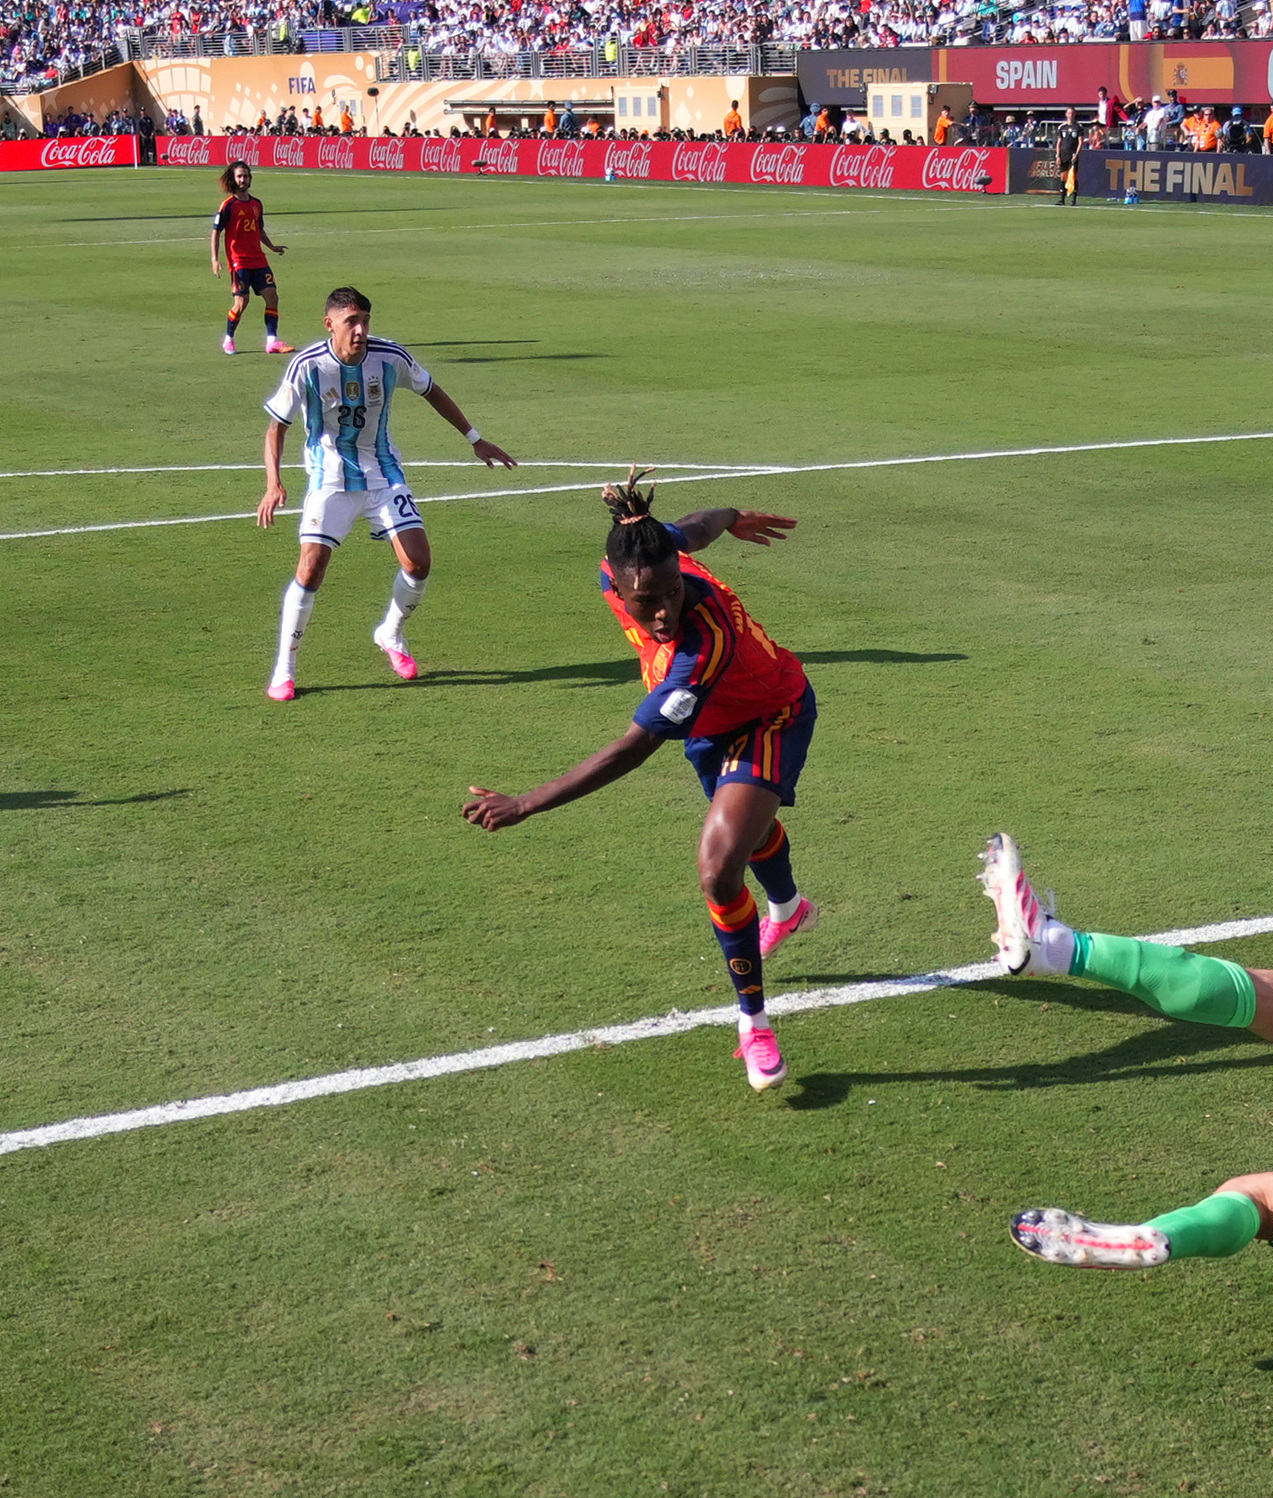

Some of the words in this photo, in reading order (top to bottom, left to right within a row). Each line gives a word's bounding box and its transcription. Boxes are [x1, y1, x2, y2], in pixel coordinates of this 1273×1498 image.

[288, 77, 317, 95] FIFA
[826, 68, 860, 88] THE
[996, 60, 1058, 89] SPAIN
[41, 136, 118, 167] Coca-Cola
[167, 137, 211, 164] Coca-Cola
[274, 138, 304, 166] Coca-Cola
[318, 137, 353, 169] Coca-Cola
[369, 139, 404, 169] Coca-Cola
[420, 138, 461, 172] Coca-Cola
[537, 140, 585, 176] Coca-Cola
[604, 142, 652, 178] Coca-Cola
[671, 142, 728, 182] Coca-Cola
[751, 145, 806, 183] Coca-Cola
[829, 145, 896, 188] Coca-Cola
[922, 148, 990, 190] Coca-Cola
[1105, 159, 1161, 191] THE
[1166, 161, 1253, 197] FINAL
[243, 219, 256, 232] 24
[337, 405, 367, 429] 26
